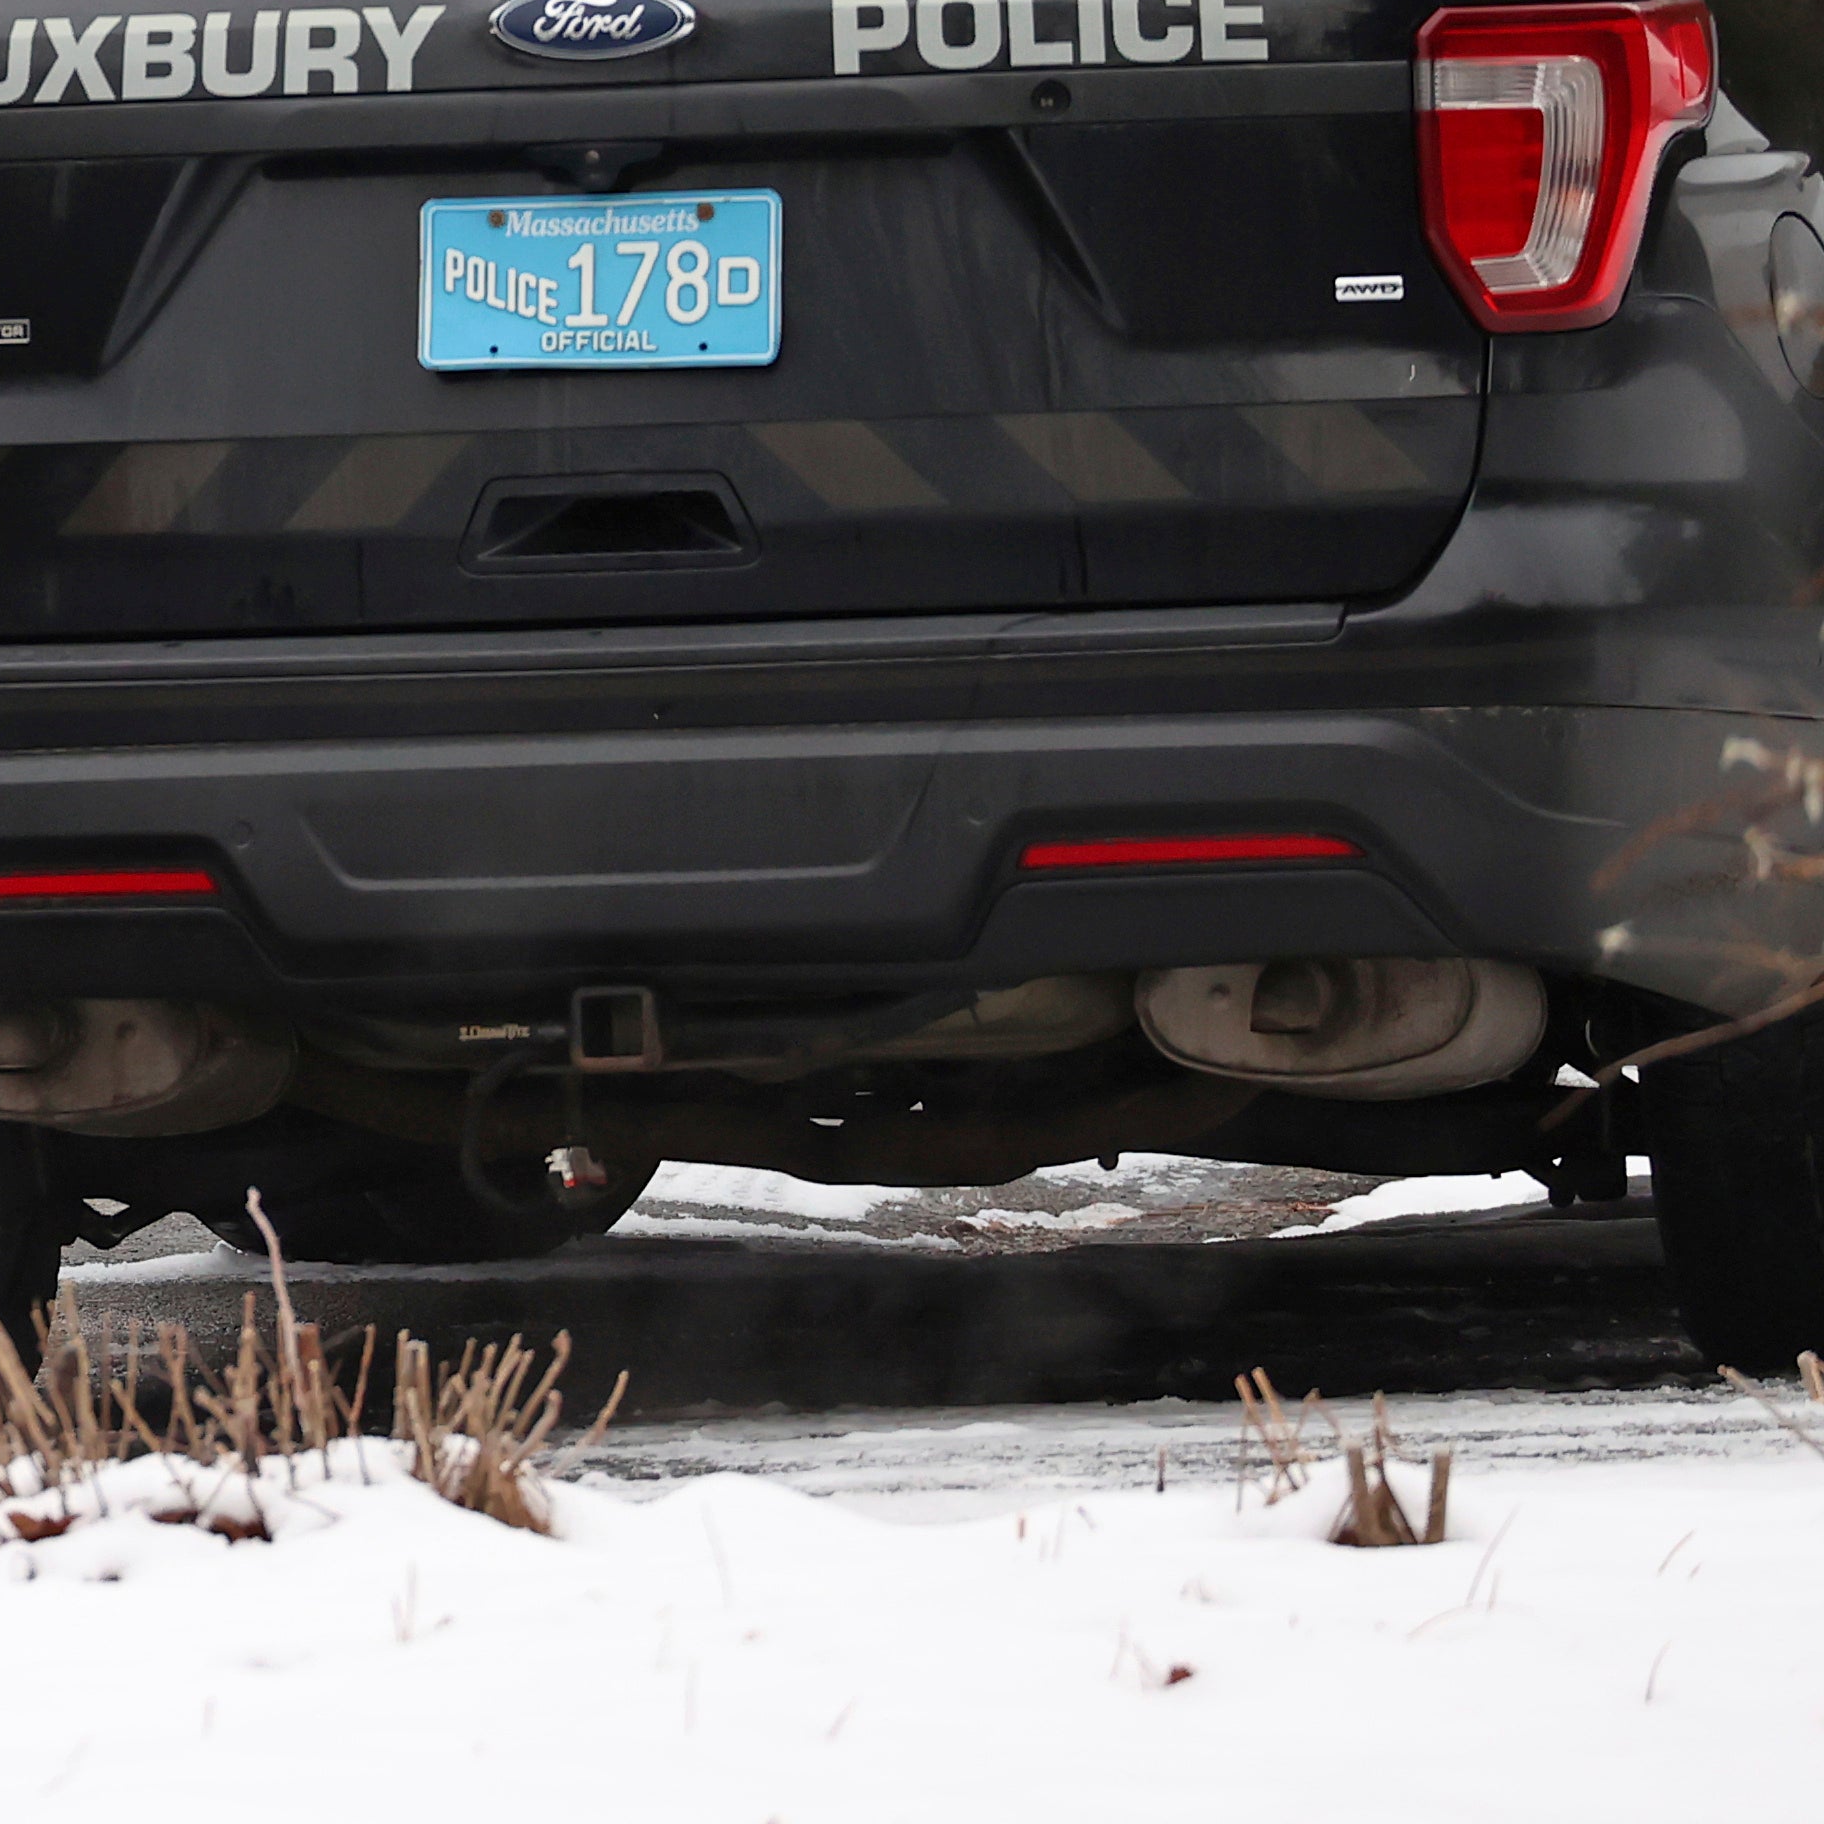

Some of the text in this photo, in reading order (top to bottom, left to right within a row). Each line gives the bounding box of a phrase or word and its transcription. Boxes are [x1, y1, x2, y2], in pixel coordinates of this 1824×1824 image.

[505, 207, 699, 238] Massachusetts
[445, 247, 558, 326] POLICE
[1341, 283, 1399, 295] AWD
[541, 330, 657, 353] OFFICIAL
